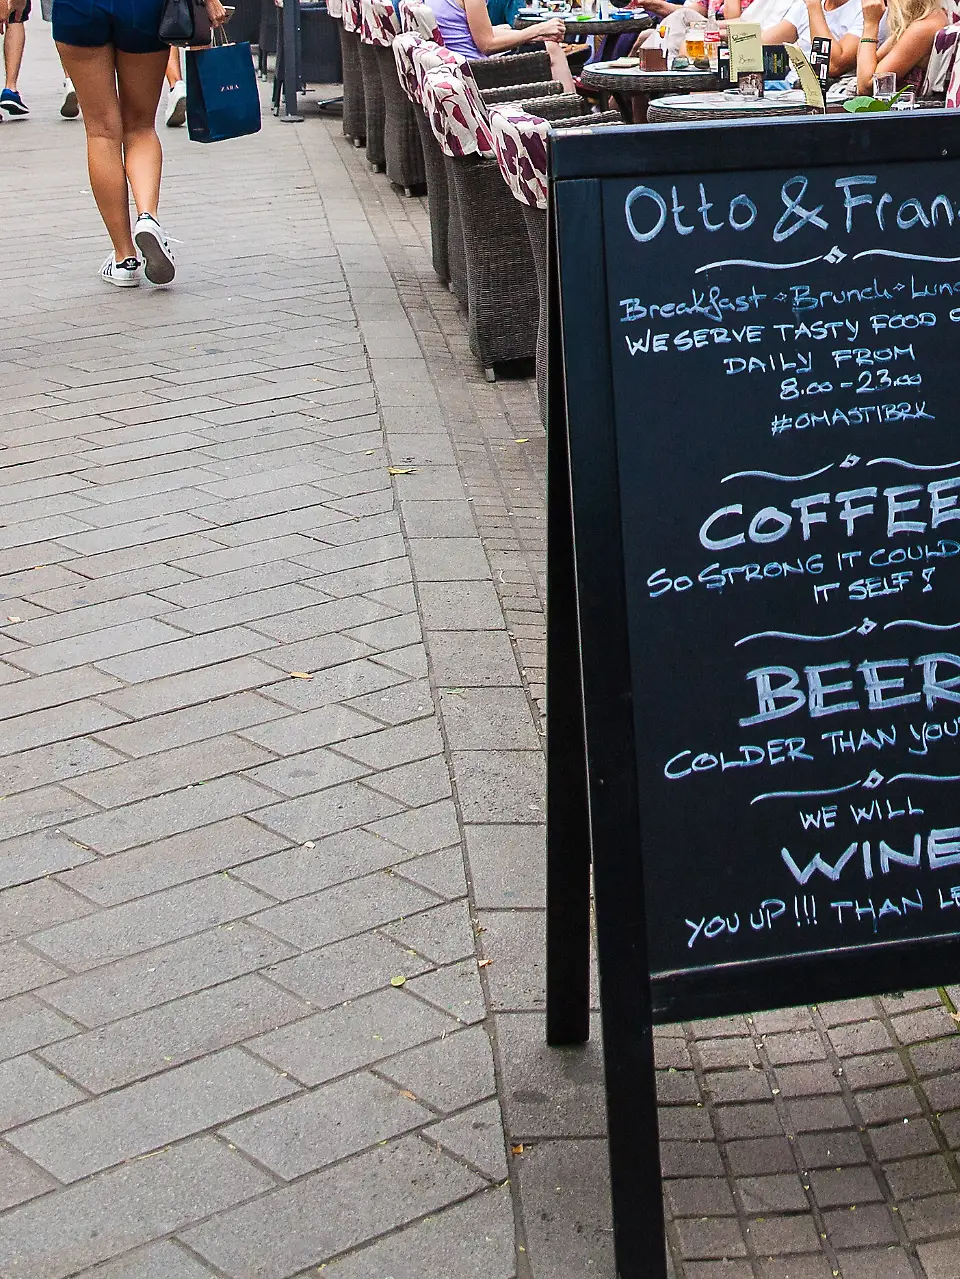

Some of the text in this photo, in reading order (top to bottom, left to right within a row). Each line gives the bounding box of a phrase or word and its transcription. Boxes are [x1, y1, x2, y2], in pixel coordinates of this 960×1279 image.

[220, 84, 239, 92] ZARA
[625, 183, 758, 242] Otto
[773, 175, 829, 242] &
[619, 286, 768, 322] Breakfast
[790, 277, 893, 312] Brunch
[625, 329, 671, 356] WE
[673, 325, 766, 352] SERVE
[773, 319, 859, 342] TASTY
[870, 312, 937, 335] FOOD
[723, 344, 916, 375] DAILY FROM
[698, 553, 824, 590] STRONG
[837, 550, 862, 571] IT
[869, 540, 960, 568] COULD
[813, 582, 840, 605] IT
[664, 736, 813, 780] COLDER
[821, 724, 897, 754] THAN
[800, 796, 924, 830] WE WILL
[685, 914, 740, 948] YOU
[830, 889, 924, 924] THAN
